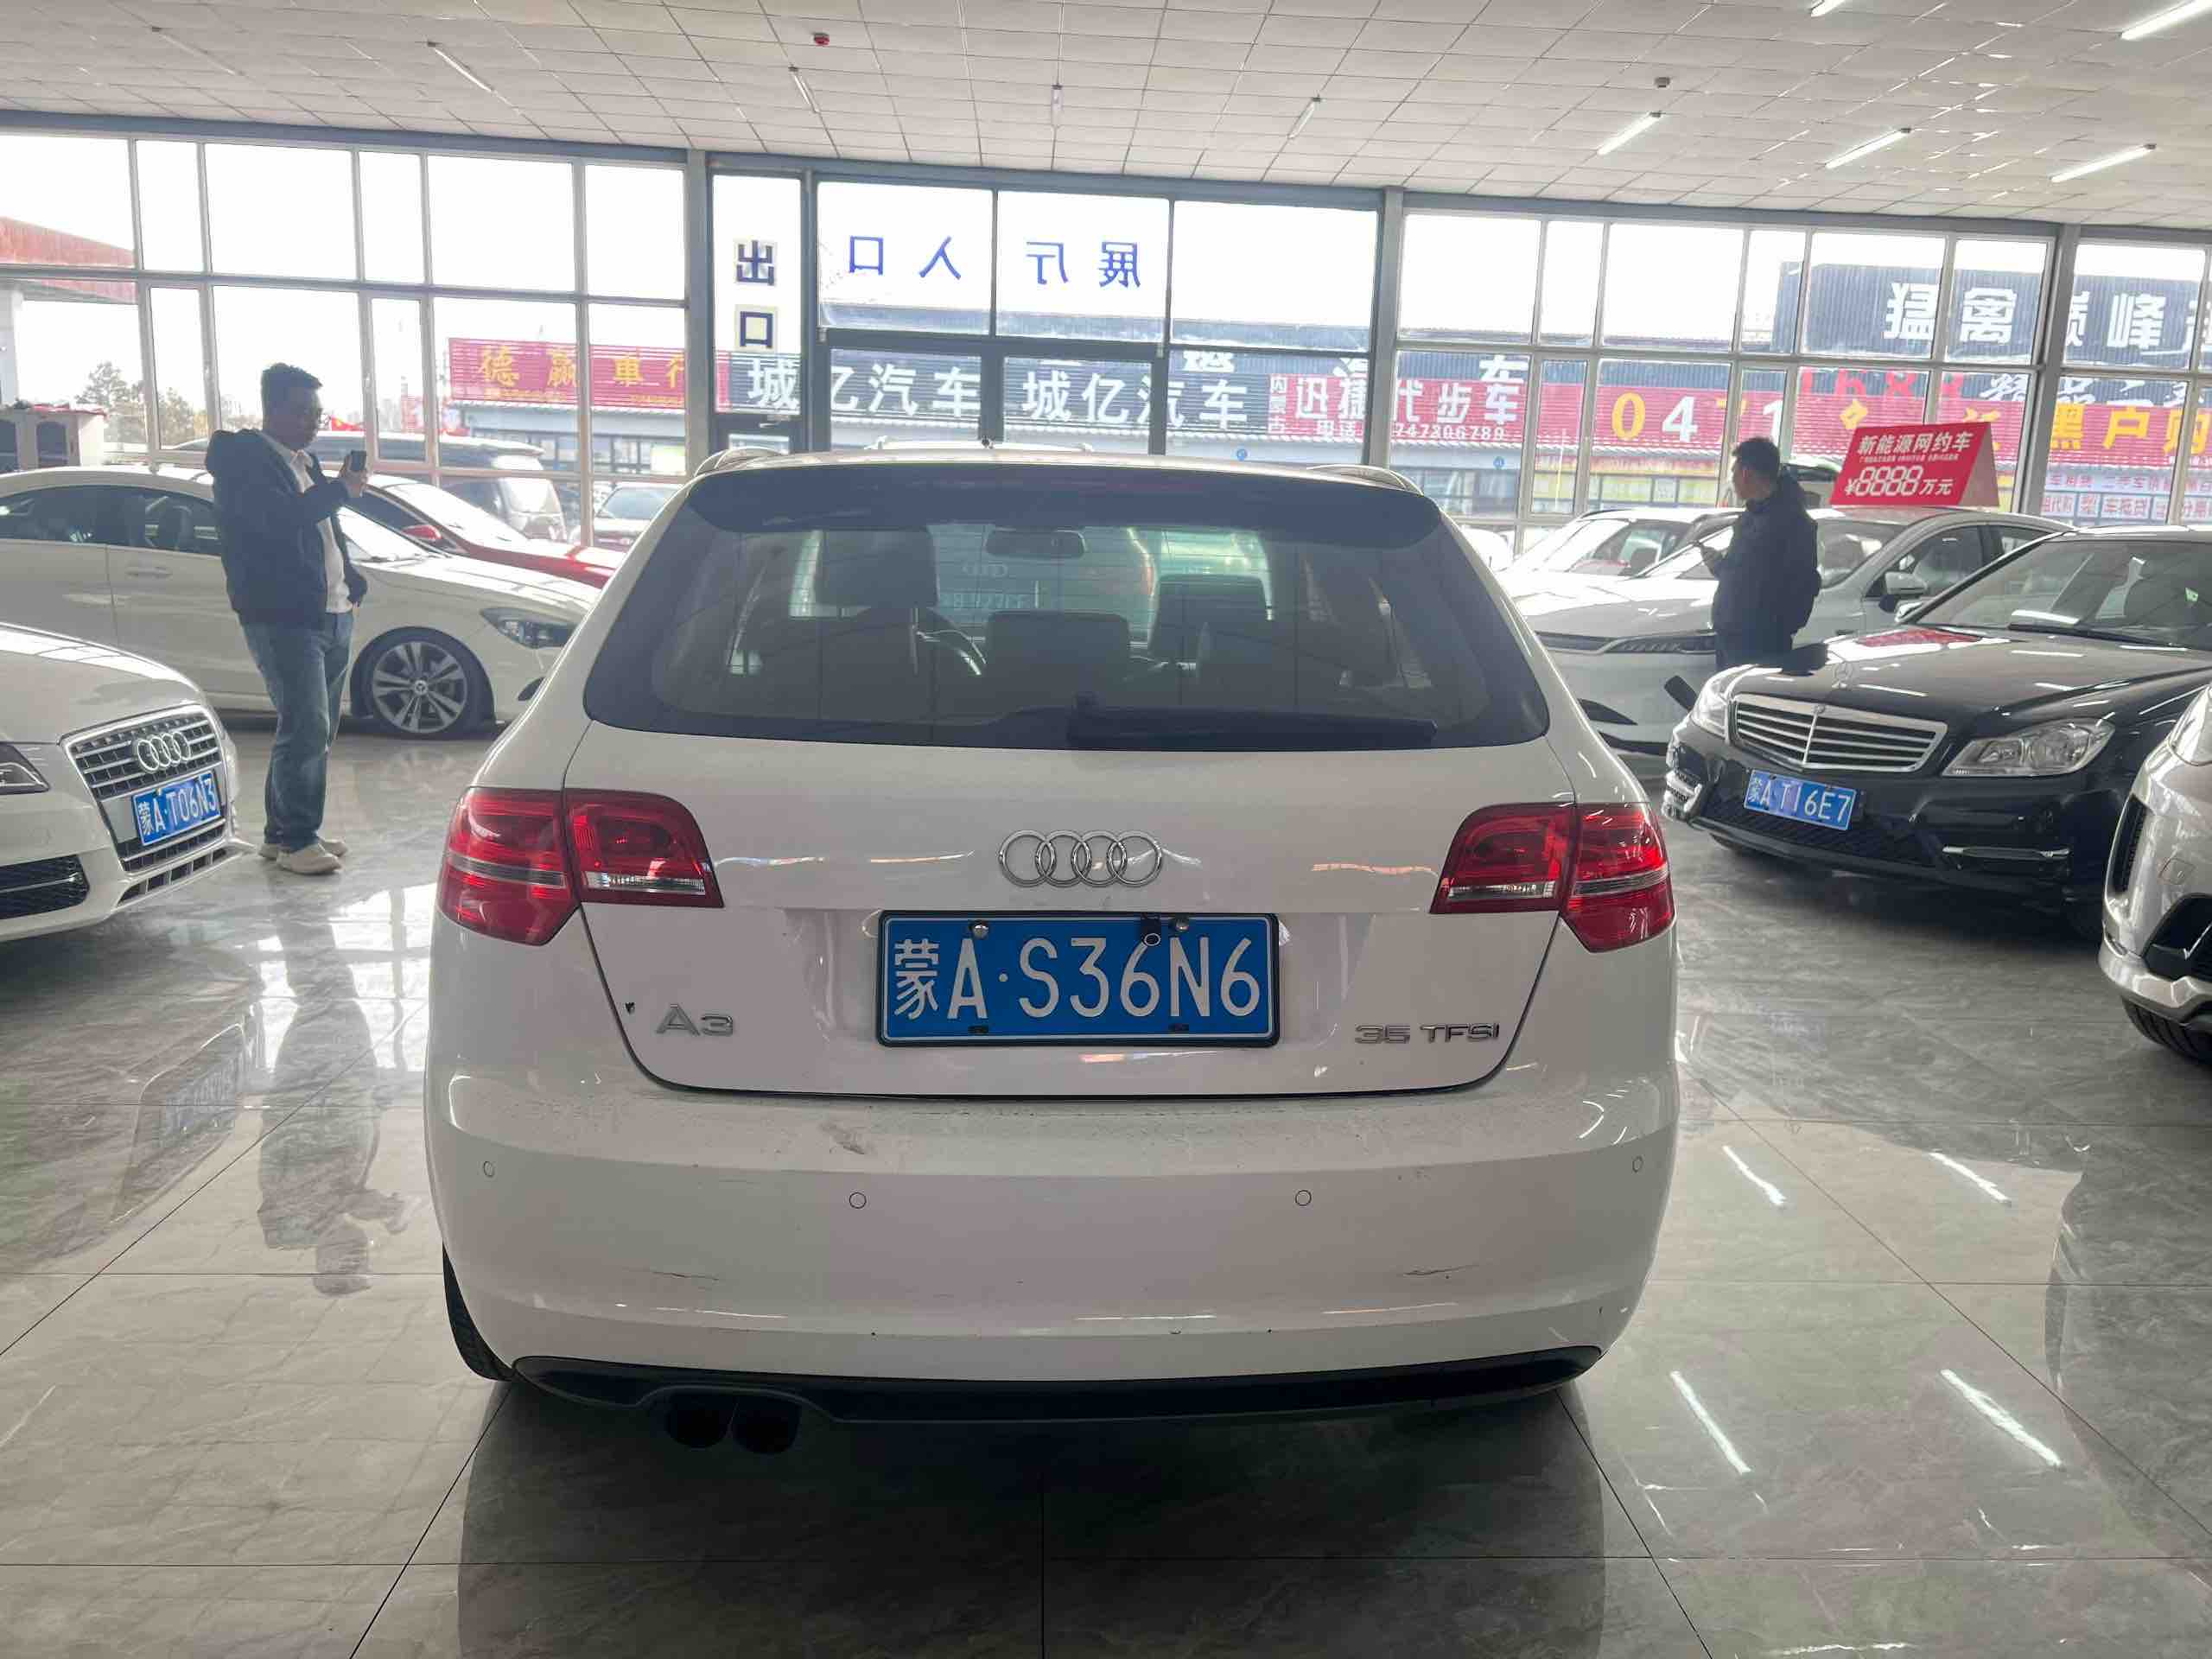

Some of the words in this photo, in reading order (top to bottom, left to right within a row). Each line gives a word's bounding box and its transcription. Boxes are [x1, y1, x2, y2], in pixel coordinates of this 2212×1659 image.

[736, 238, 776, 349] 出口
[748, 356, 982, 418] 城亿汽车
[1022, 372, 1248, 431] 城亿汽车
[1857, 432, 1974, 455] 新能源网约车
[893, 938, 1261, 1020] 蒙A·S36N6
[655, 1003, 734, 1037] A3
[1354, 1023, 1411, 1044] 35
[1420, 1022, 1500, 1044] TFSI
